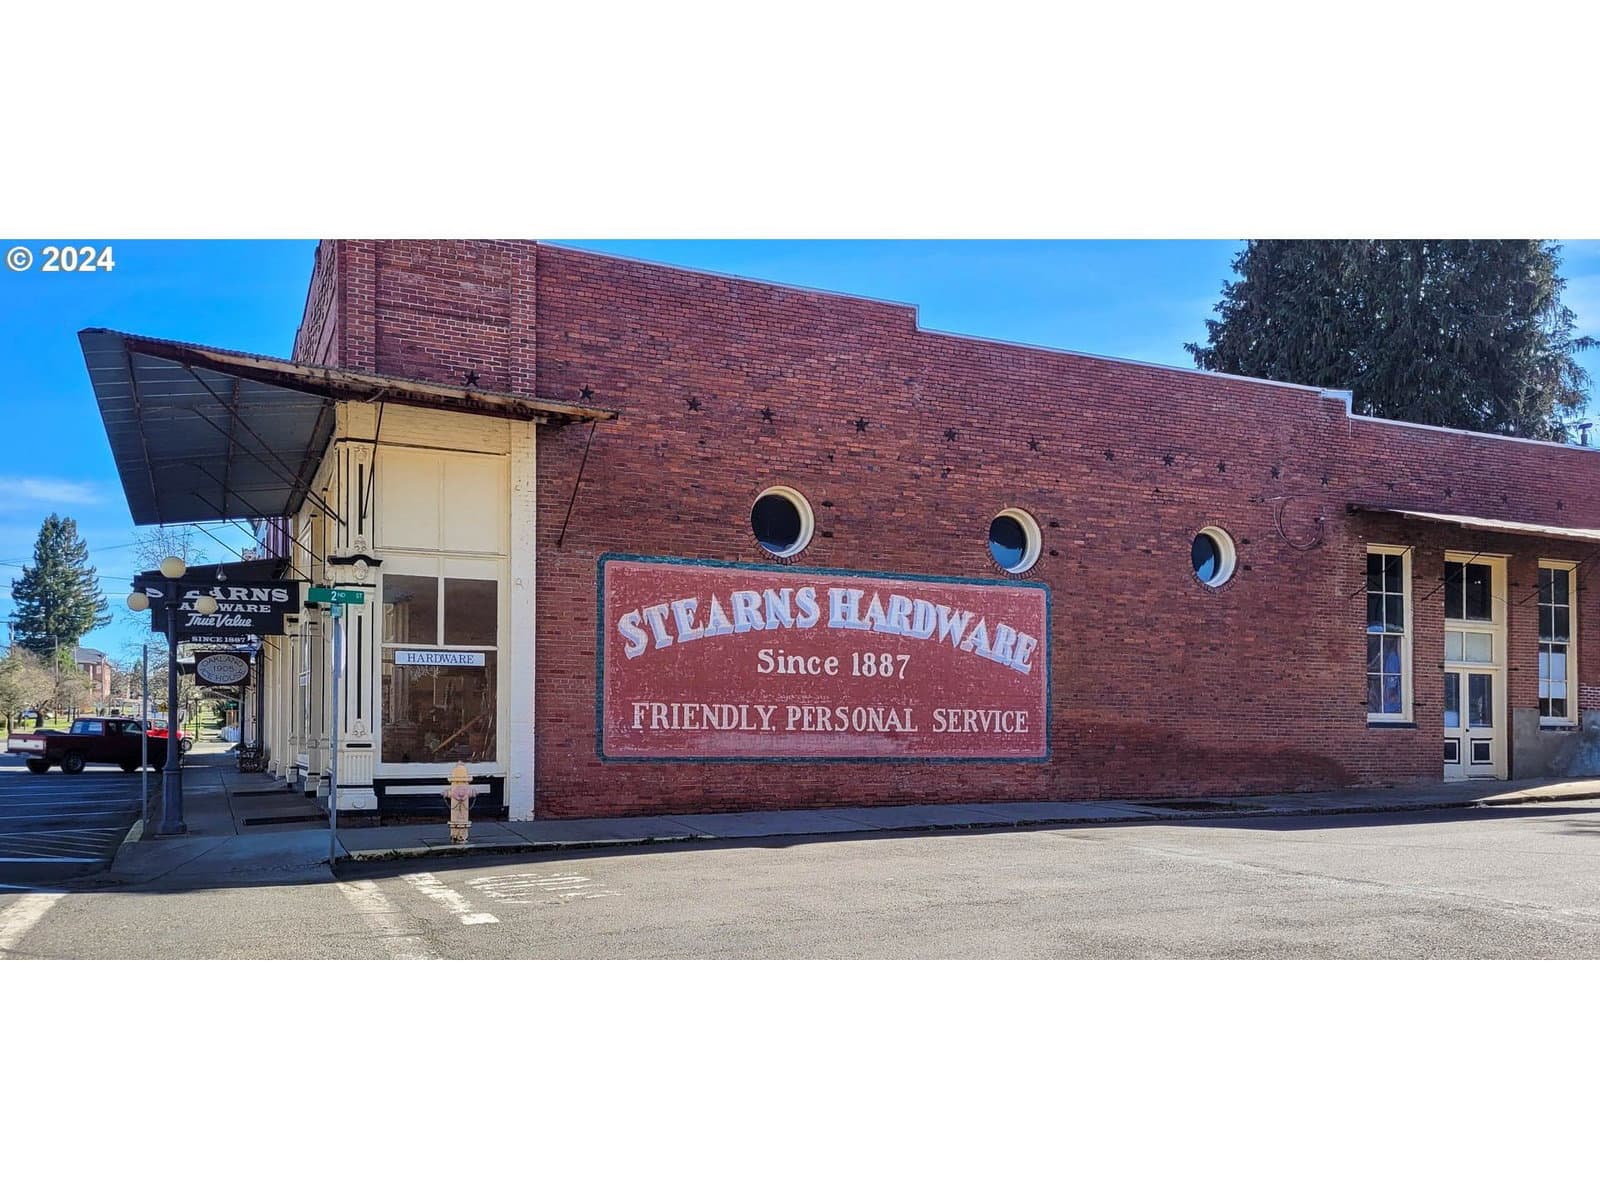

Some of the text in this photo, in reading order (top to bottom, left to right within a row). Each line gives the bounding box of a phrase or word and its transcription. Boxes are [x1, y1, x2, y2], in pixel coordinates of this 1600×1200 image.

[191, 635, 223, 643] SINCE
[617, 587, 1038, 676] STEARNS HARDWARE
[407, 653, 475, 664] HARDWARE
[757, 649, 911, 679] Since 1887
[785, 705, 918, 732] PERSONAL
[932, 708, 1029, 733] SERVICE
